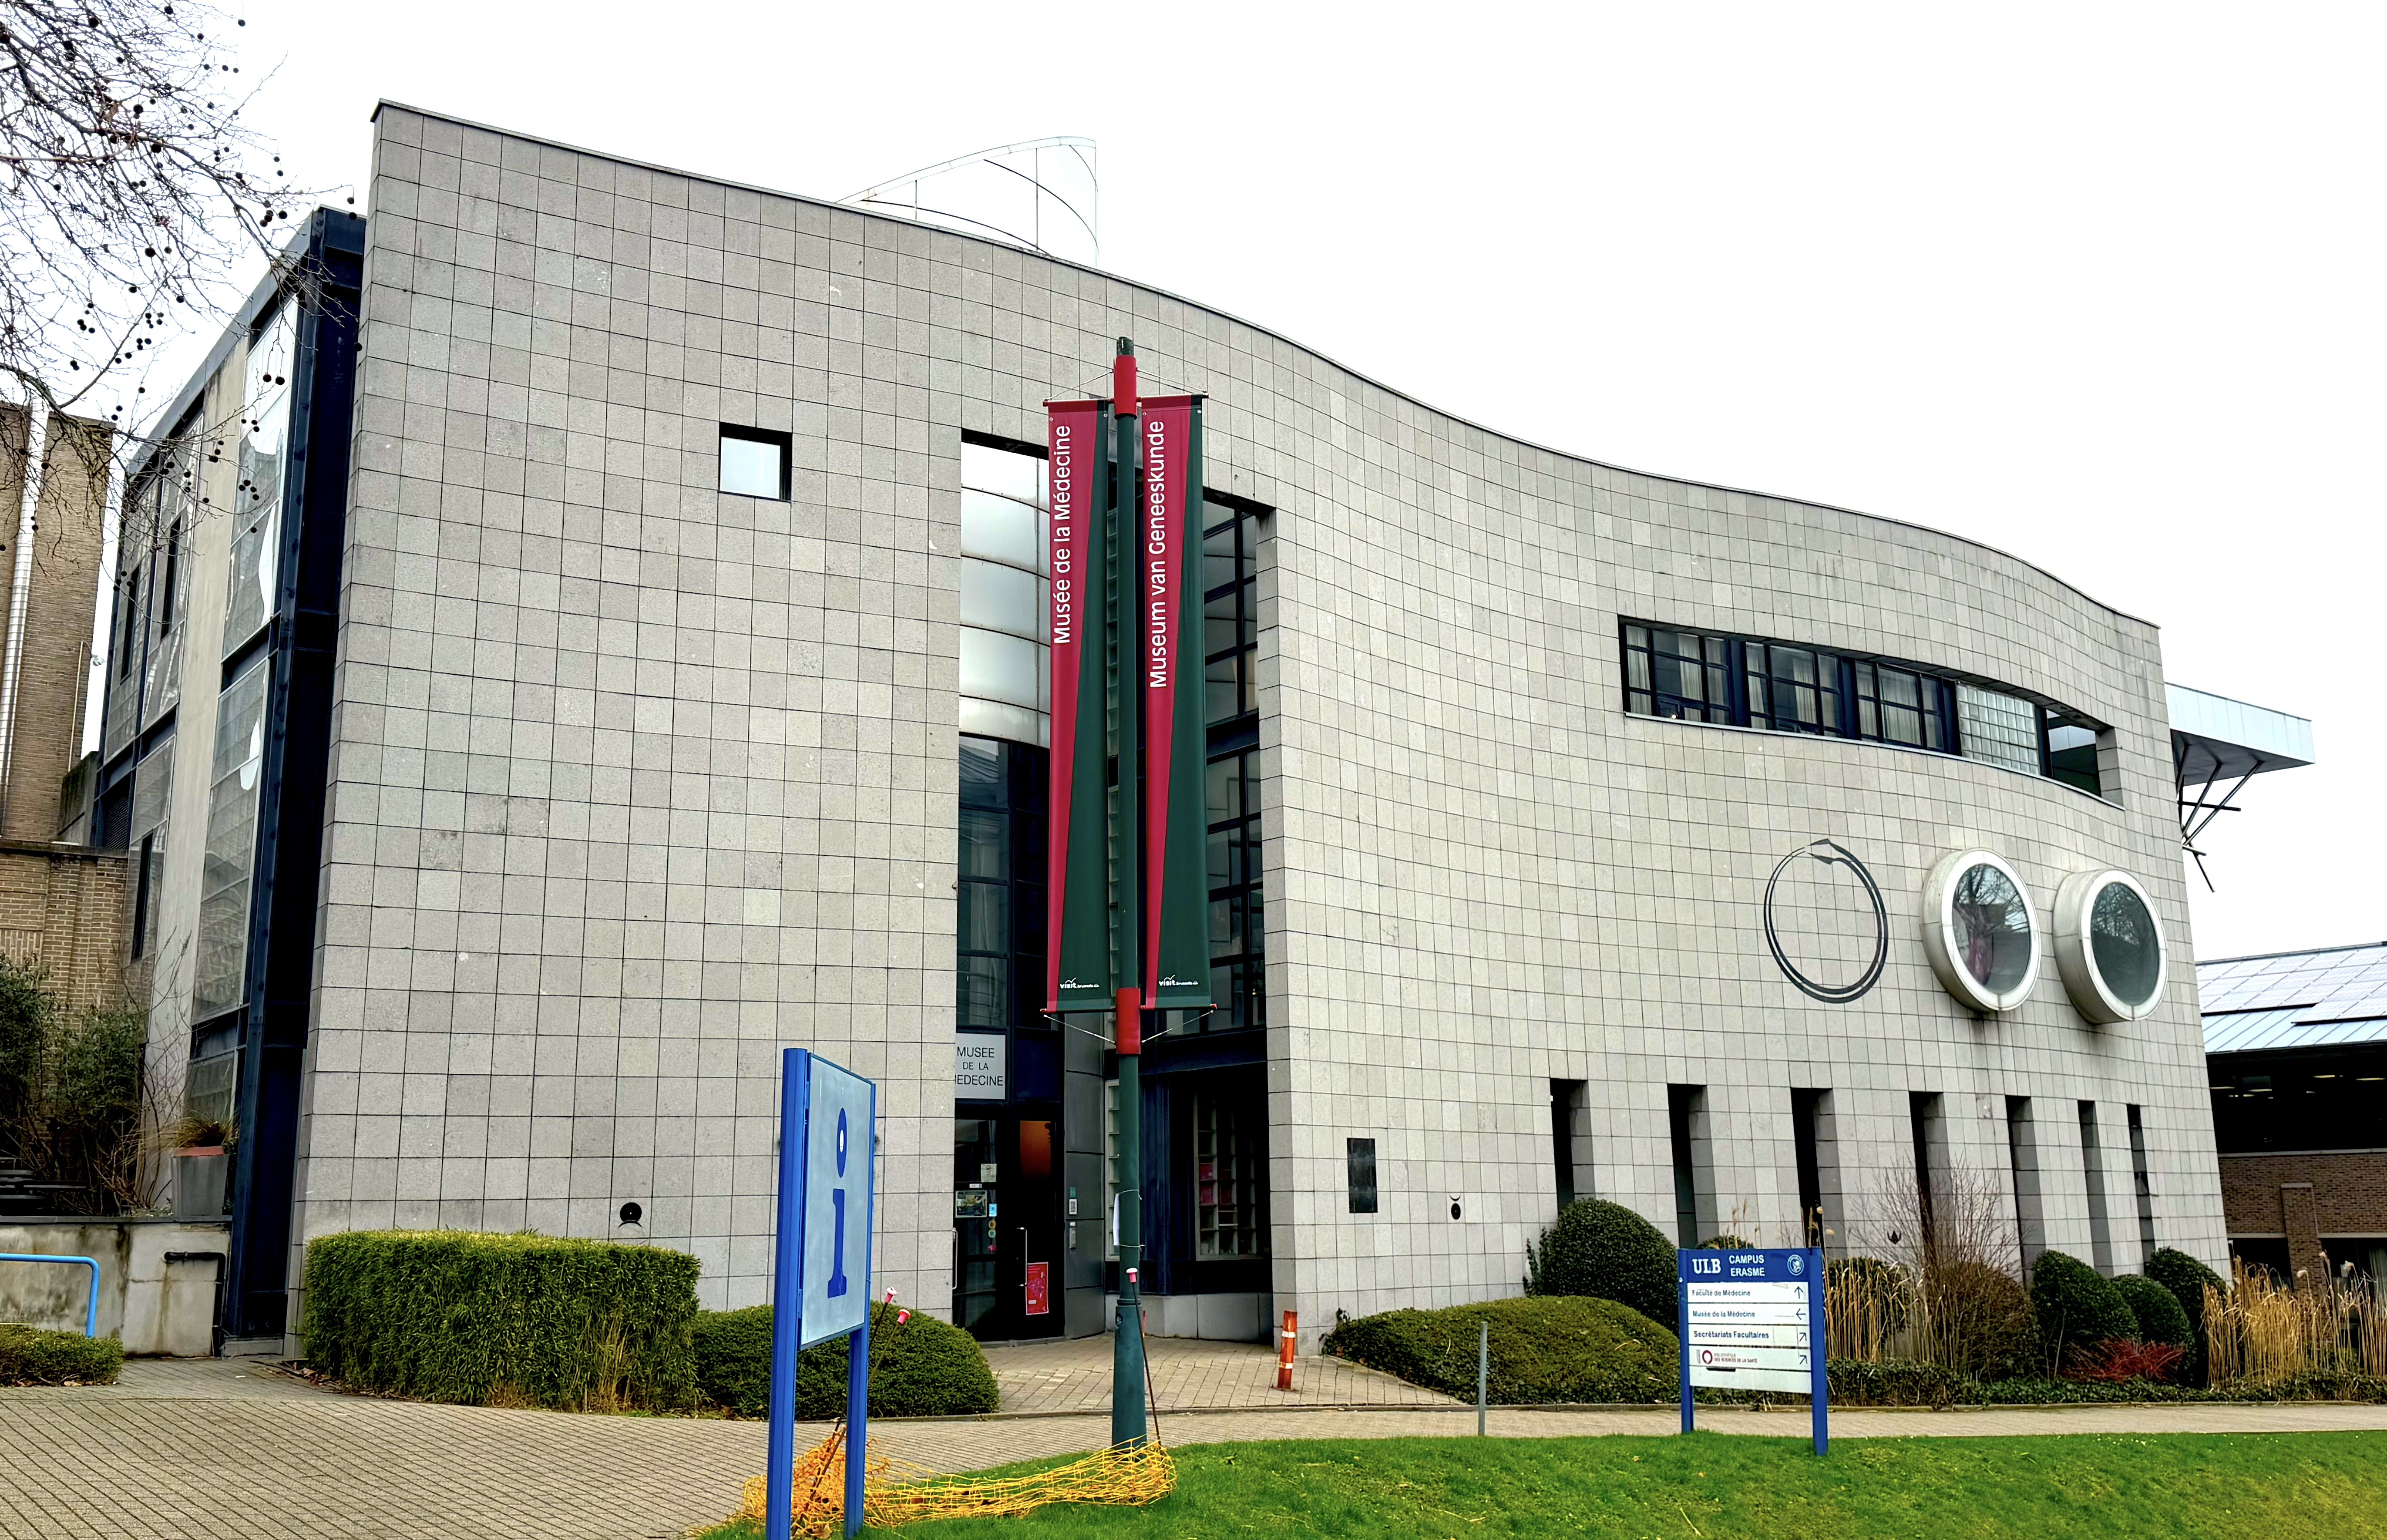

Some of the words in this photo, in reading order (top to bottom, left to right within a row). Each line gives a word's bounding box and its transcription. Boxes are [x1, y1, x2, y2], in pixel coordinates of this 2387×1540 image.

[1053, 426, 1070, 520] Médecine
[1147, 421, 1165, 555] Geneeskunde
[1053, 527, 1070, 542] la
[1053, 549, 1070, 573] de
[1151, 561, 1166, 596] van
[1053, 579, 1070, 643] Musée
[1150, 602, 1167, 687] Museum
[957, 1046, 995, 1058] MUSEE
[963, 1062, 974, 1070] DE
[978, 1062, 988, 1070] LA
[955, 1074, 1003, 1086] EDECINE
[1692, 1258, 1721, 1274] ULB
[1729, 1254, 1764, 1264] CAMPUS
[1730, 1267, 1765, 1277] ERASME
